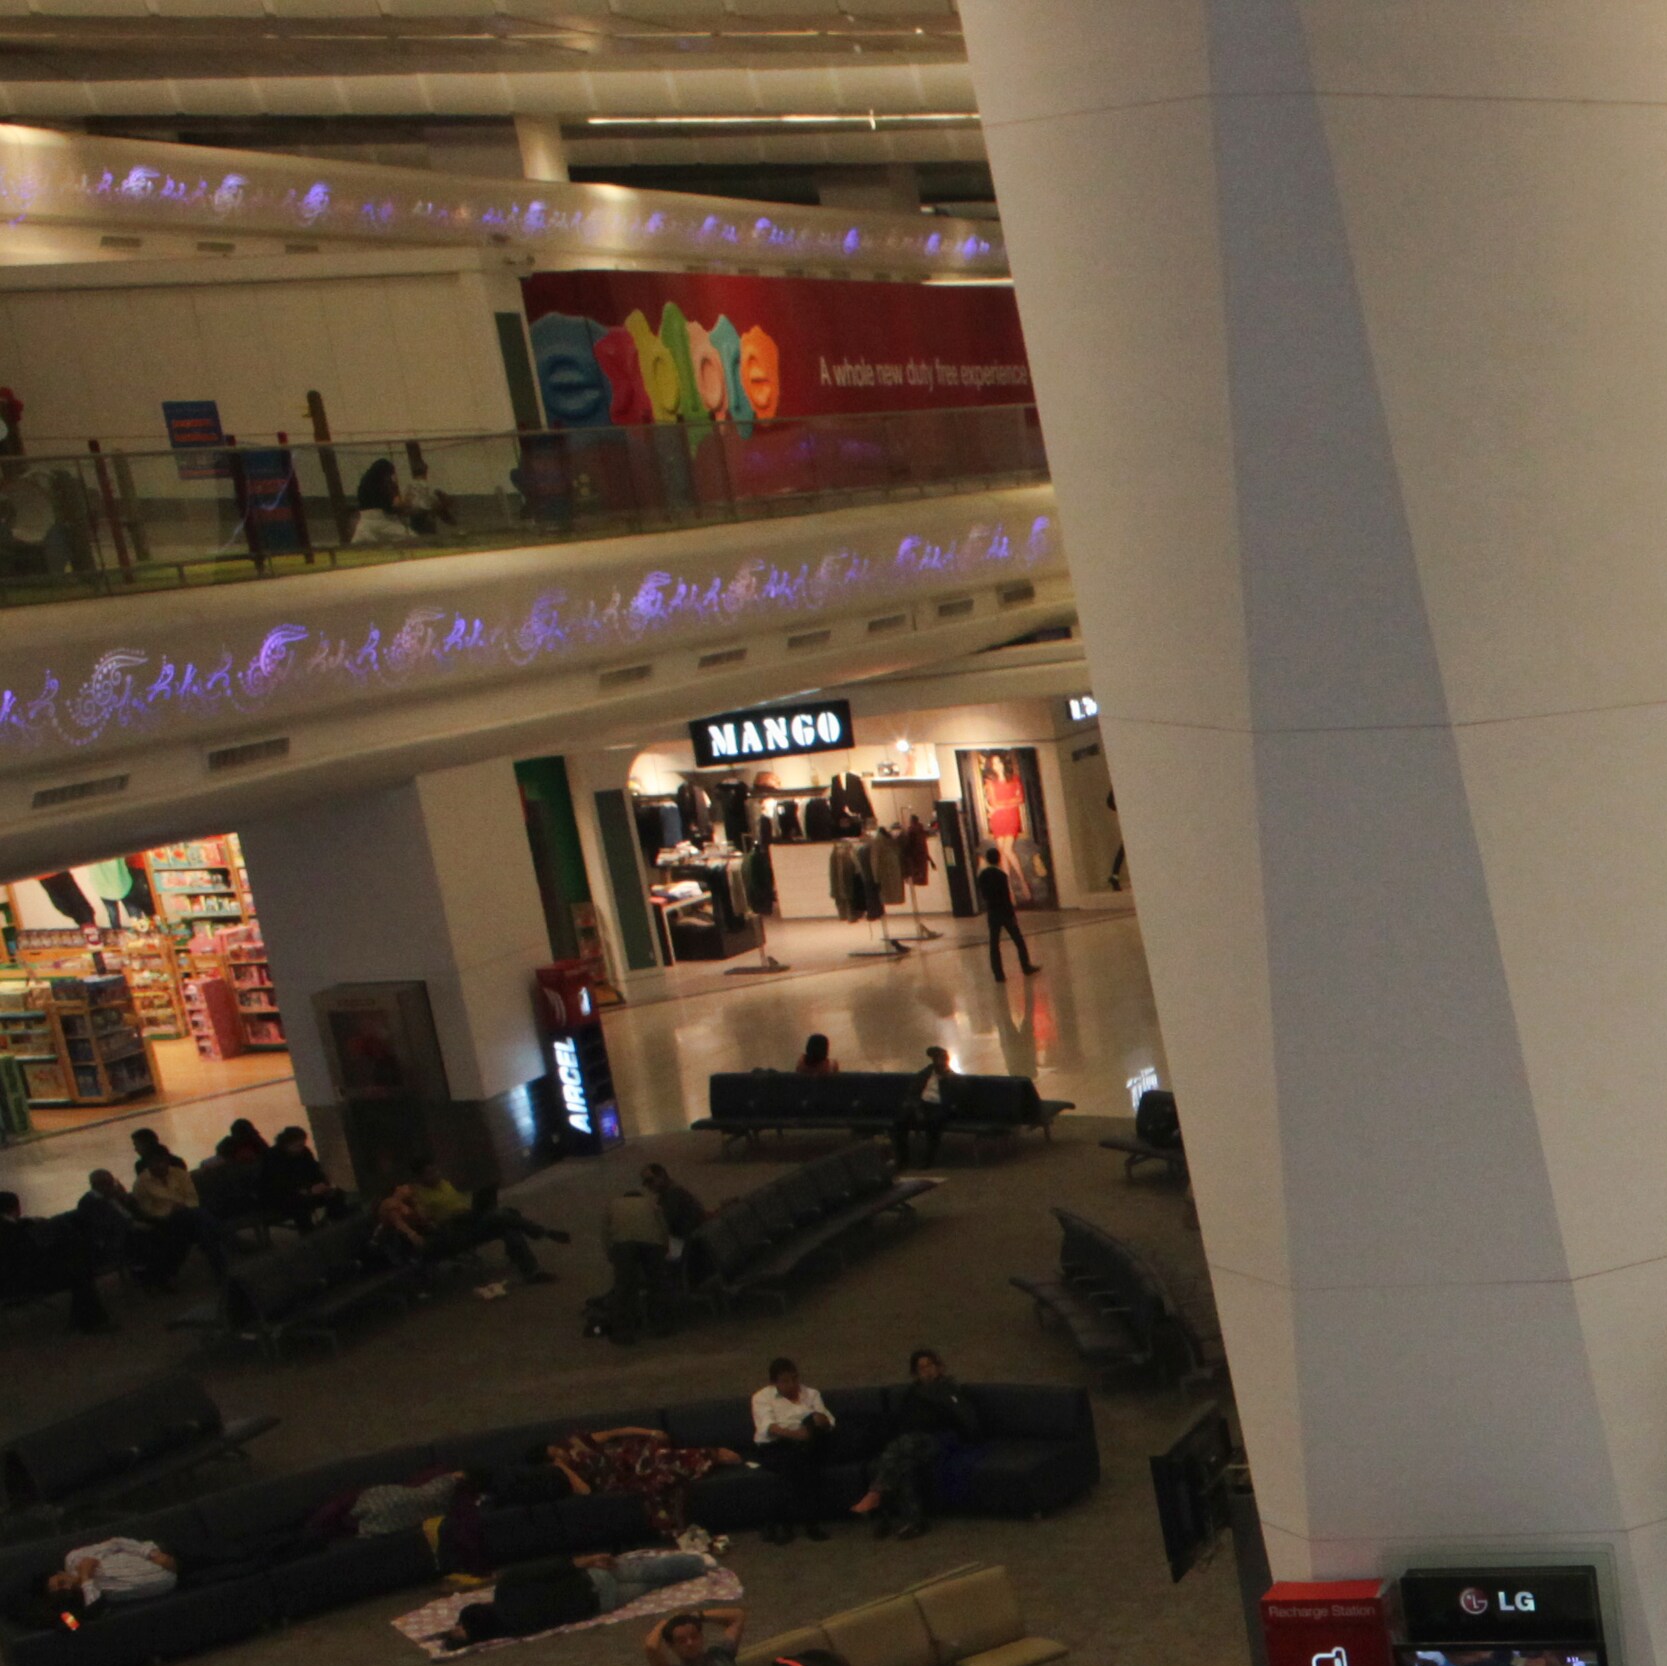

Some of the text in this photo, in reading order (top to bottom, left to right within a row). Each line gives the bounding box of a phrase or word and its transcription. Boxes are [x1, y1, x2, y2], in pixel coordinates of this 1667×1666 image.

[706, 710, 842, 759] MANGO
[553, 1035, 593, 1136] AIRCEL
[1268, 1604, 1376, 1620] Recharge Station
[1498, 1591, 1536, 1612] LG
